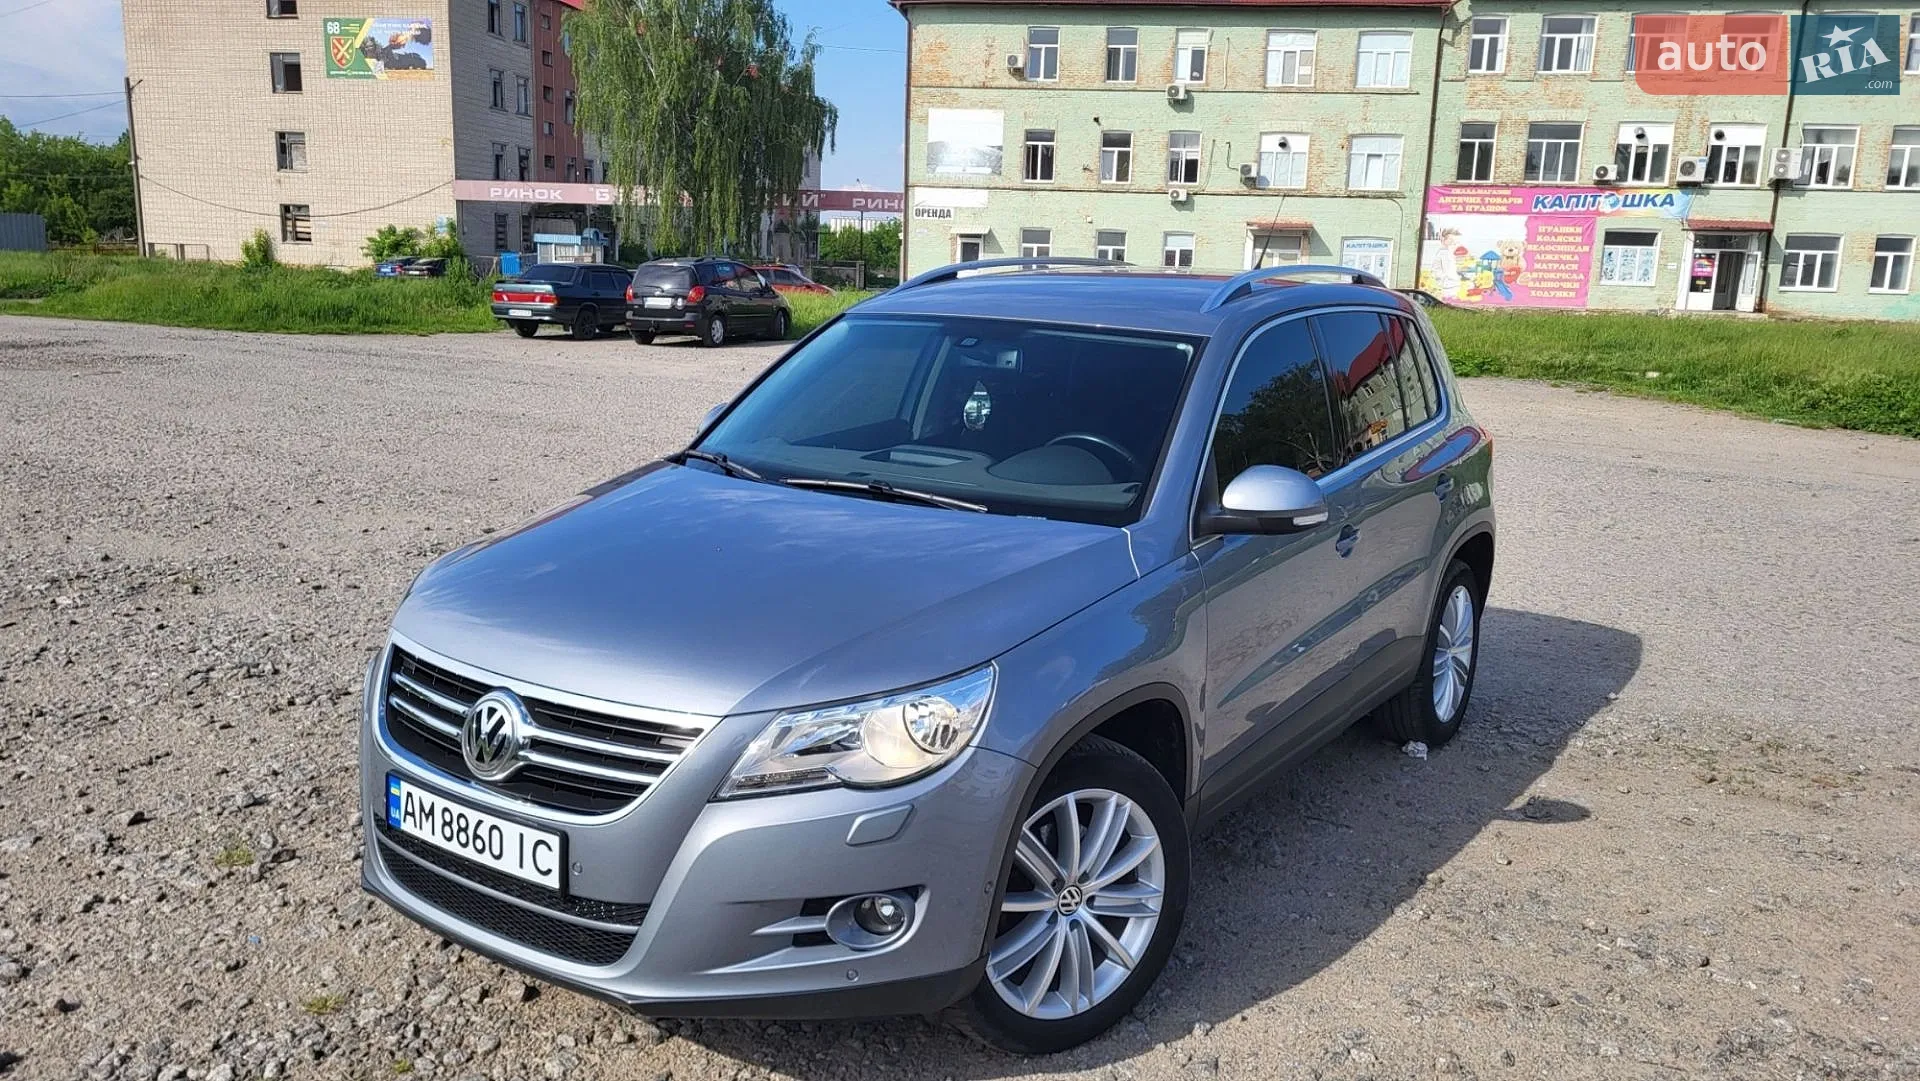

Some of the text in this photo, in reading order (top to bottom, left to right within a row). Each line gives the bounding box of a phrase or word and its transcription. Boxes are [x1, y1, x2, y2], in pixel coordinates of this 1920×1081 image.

[326, 21, 340, 34] 68
[490, 187, 563, 201] РИНОК
[852, 197, 904, 210] РИН
[914, 208, 952, 219] ОРЕНДА
[390, 808, 400, 820] UA
[518, 832, 553, 877] IC
